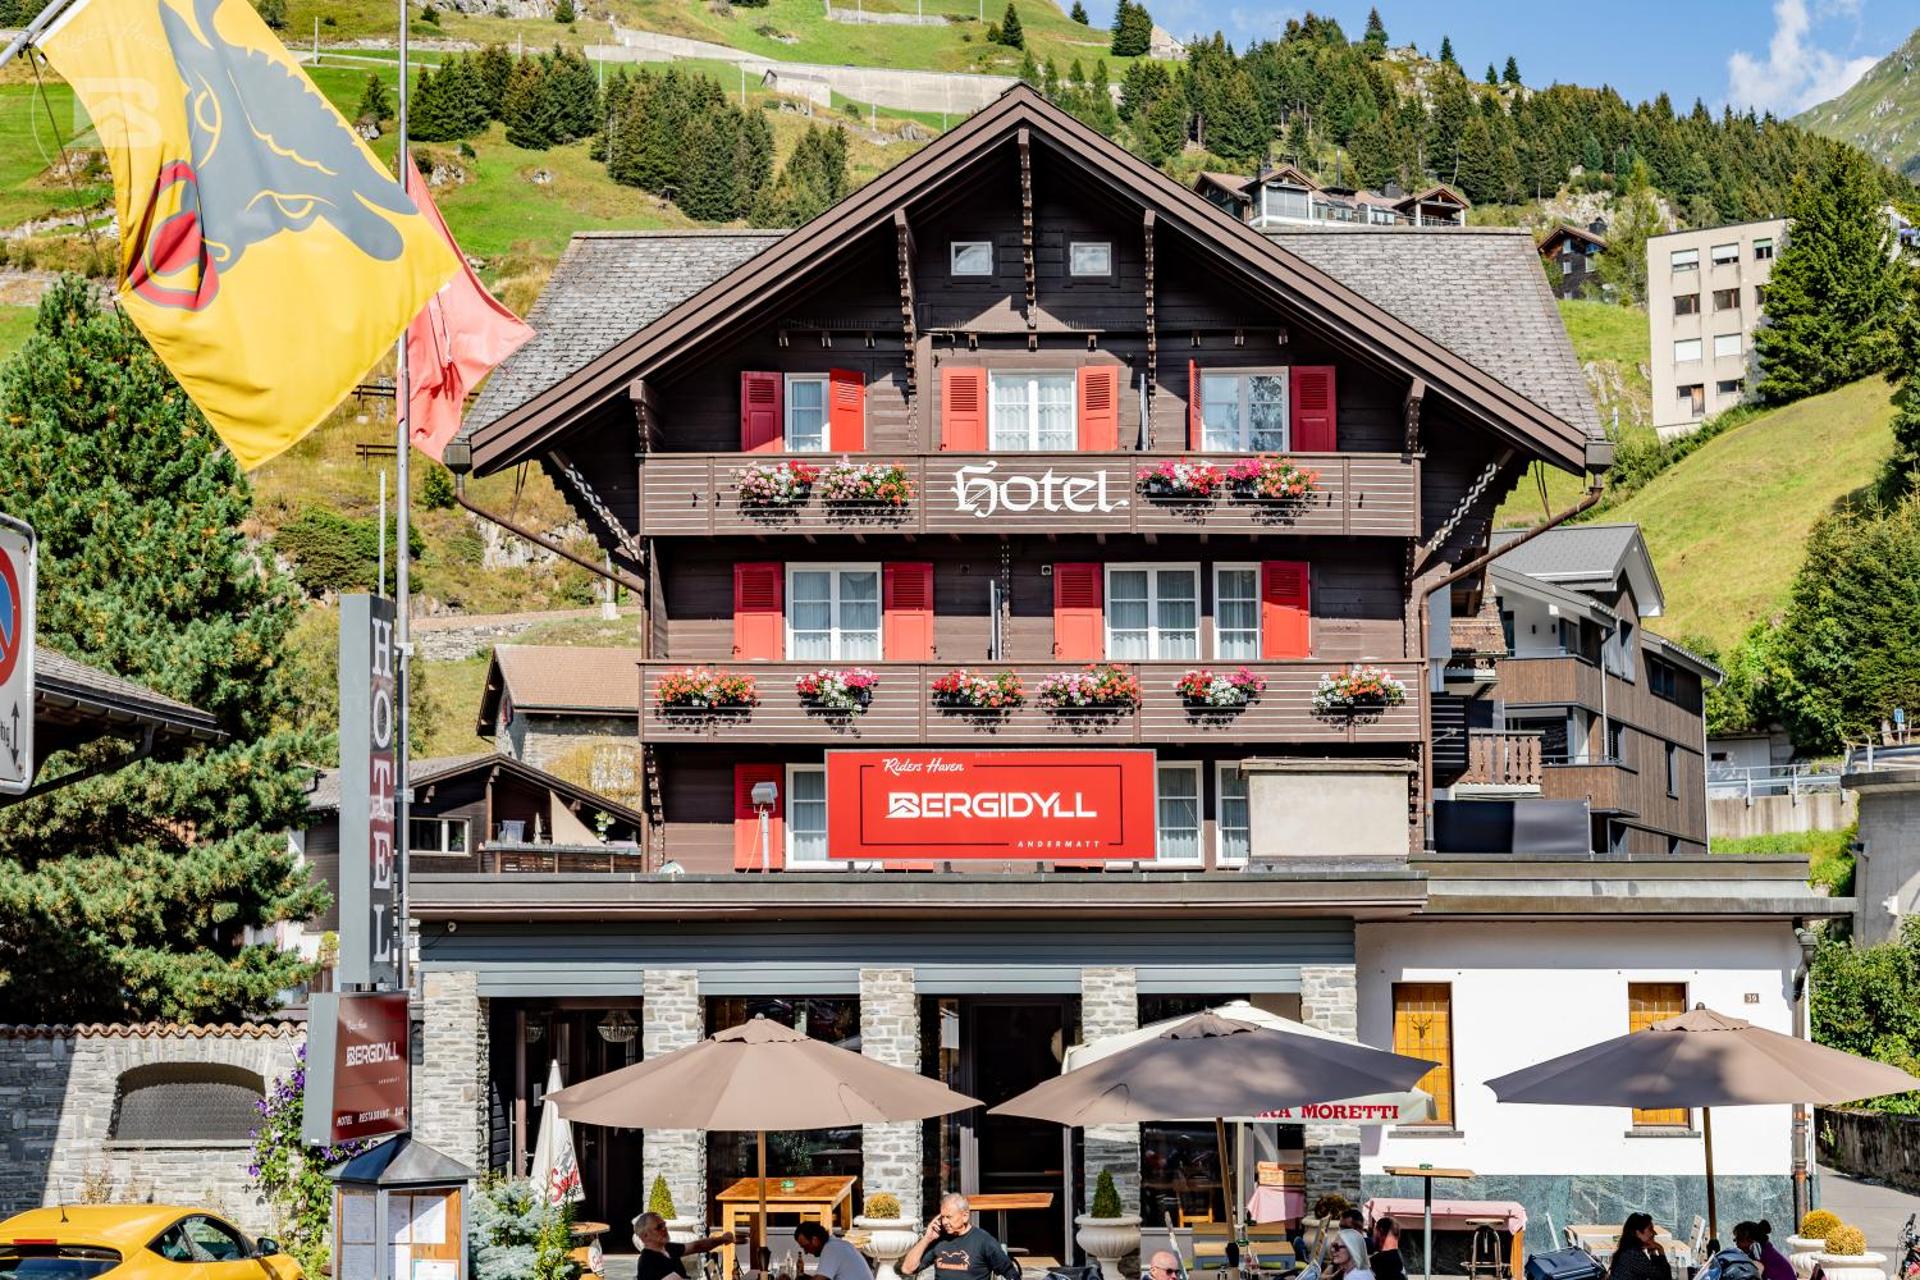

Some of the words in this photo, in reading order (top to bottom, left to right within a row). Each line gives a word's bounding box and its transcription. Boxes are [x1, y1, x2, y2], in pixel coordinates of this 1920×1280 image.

[950, 460, 1130, 518] Hotel
[882, 757, 923, 776] Riders
[925, 757, 965, 773] Haven
[372, 617, 392, 963] HOTEL
[885, 792, 1098, 819] BERGIDYLL
[1017, 839, 1101, 849] ANDERMATT
[1302, 1105, 1398, 1119] MORETTI
